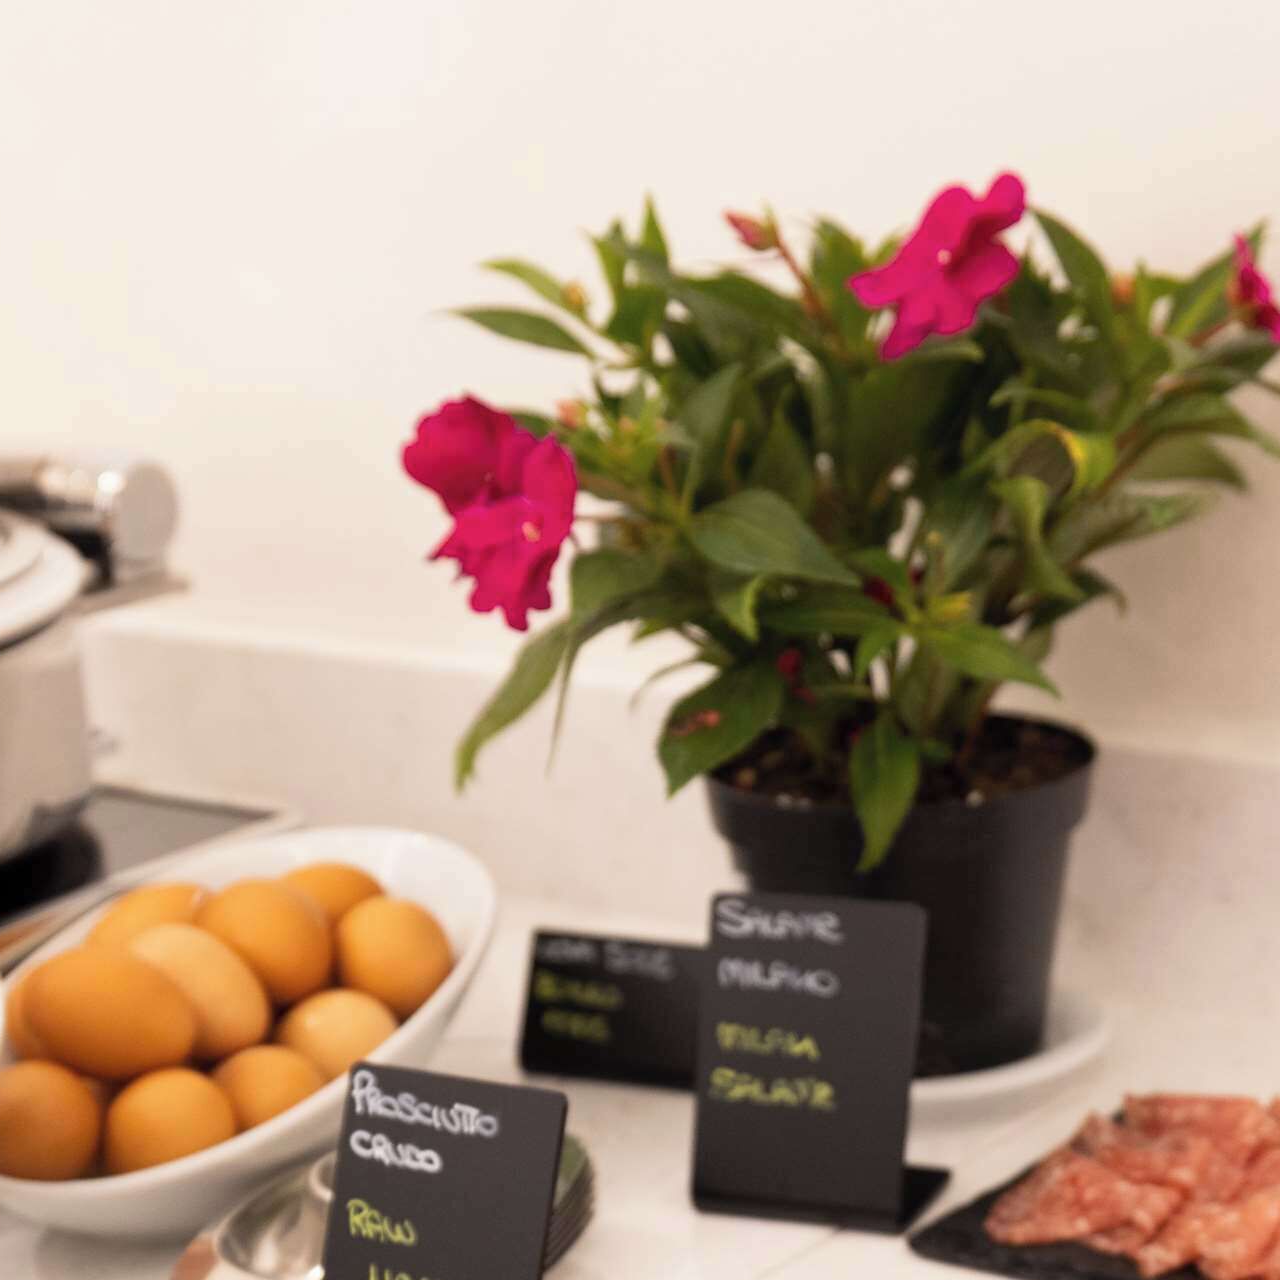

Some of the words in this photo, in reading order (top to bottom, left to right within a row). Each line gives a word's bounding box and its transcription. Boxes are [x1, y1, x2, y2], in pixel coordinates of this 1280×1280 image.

[352, 1069, 499, 1137] PROSCIUTTO
[349, 1128, 443, 1174] CRUDO
[347, 1198, 417, 1246] RAW
